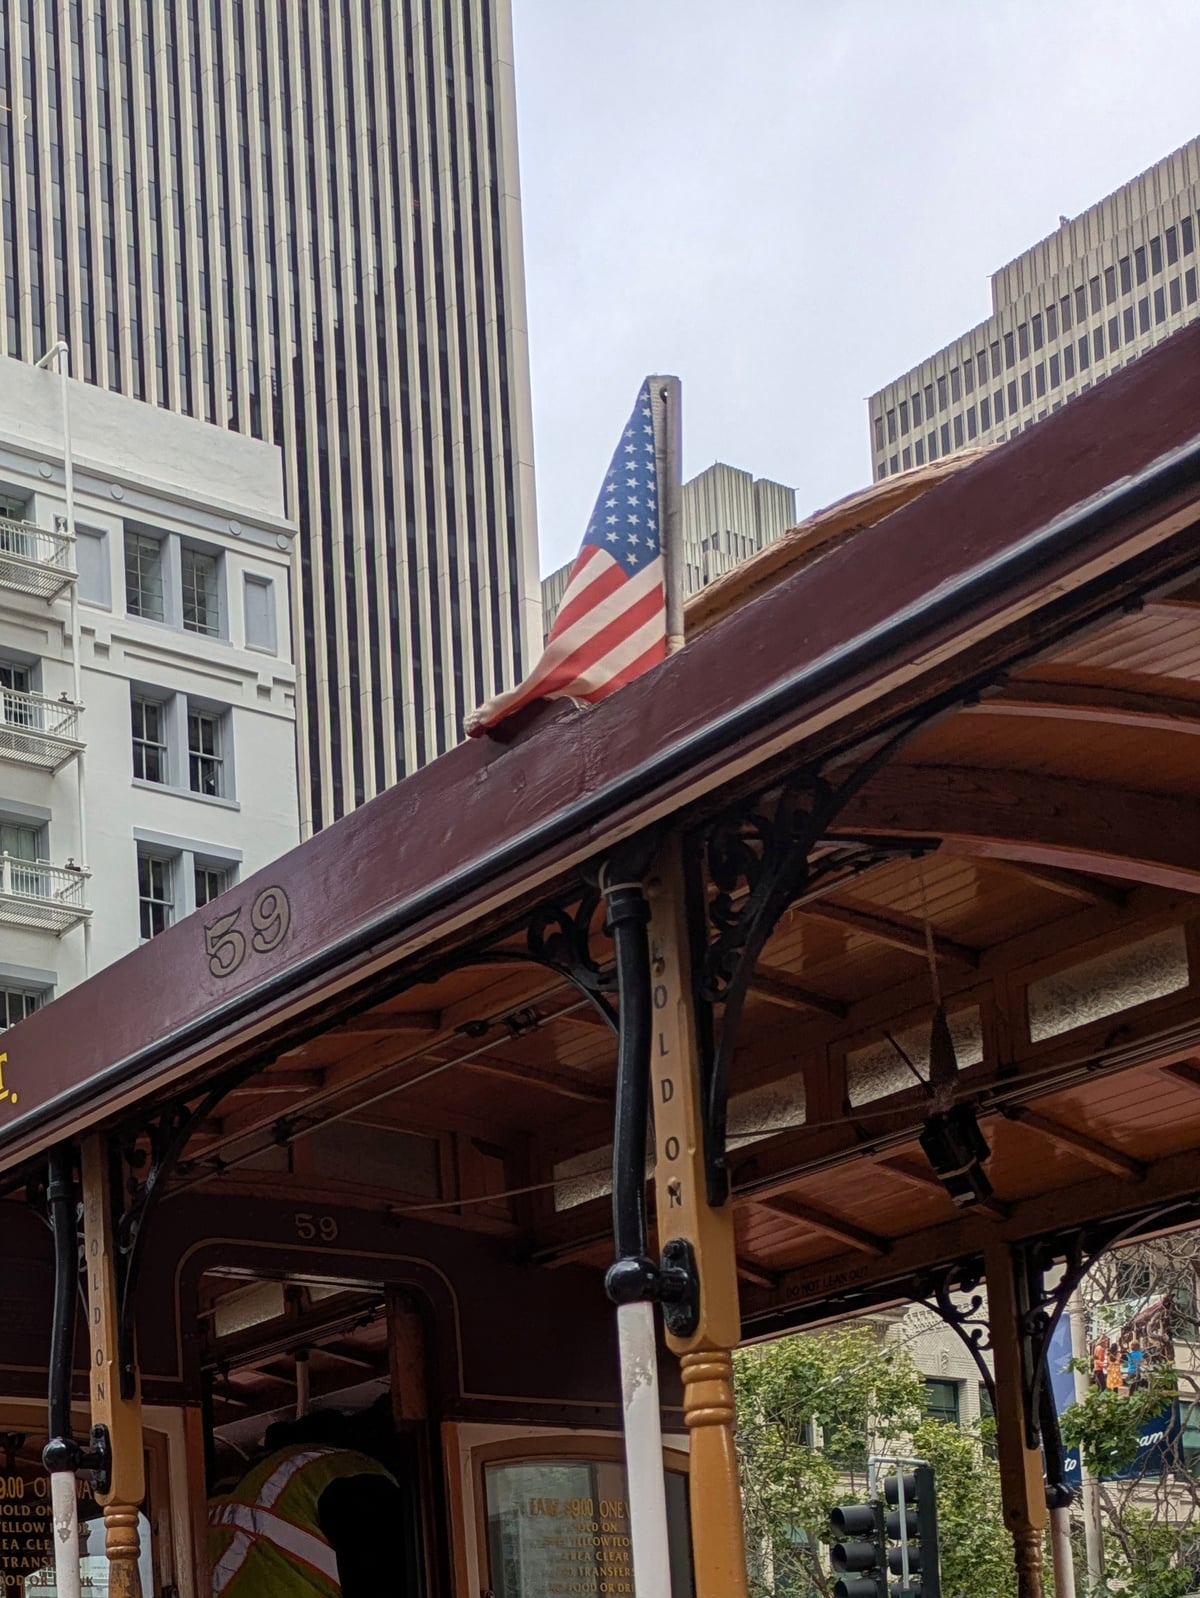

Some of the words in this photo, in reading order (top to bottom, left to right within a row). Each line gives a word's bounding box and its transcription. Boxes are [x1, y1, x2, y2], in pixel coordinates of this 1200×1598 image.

[203, 885, 291, 978] 59
[294, 1213, 338, 1242] 59
[599, 1500, 624, 1519] ONE
[602, 1522, 617, 1533] ON
[596, 1551, 629, 1562] CLEAR
[29, 1576, 47, 1587] OR
[600, 1582, 614, 1594] OR
